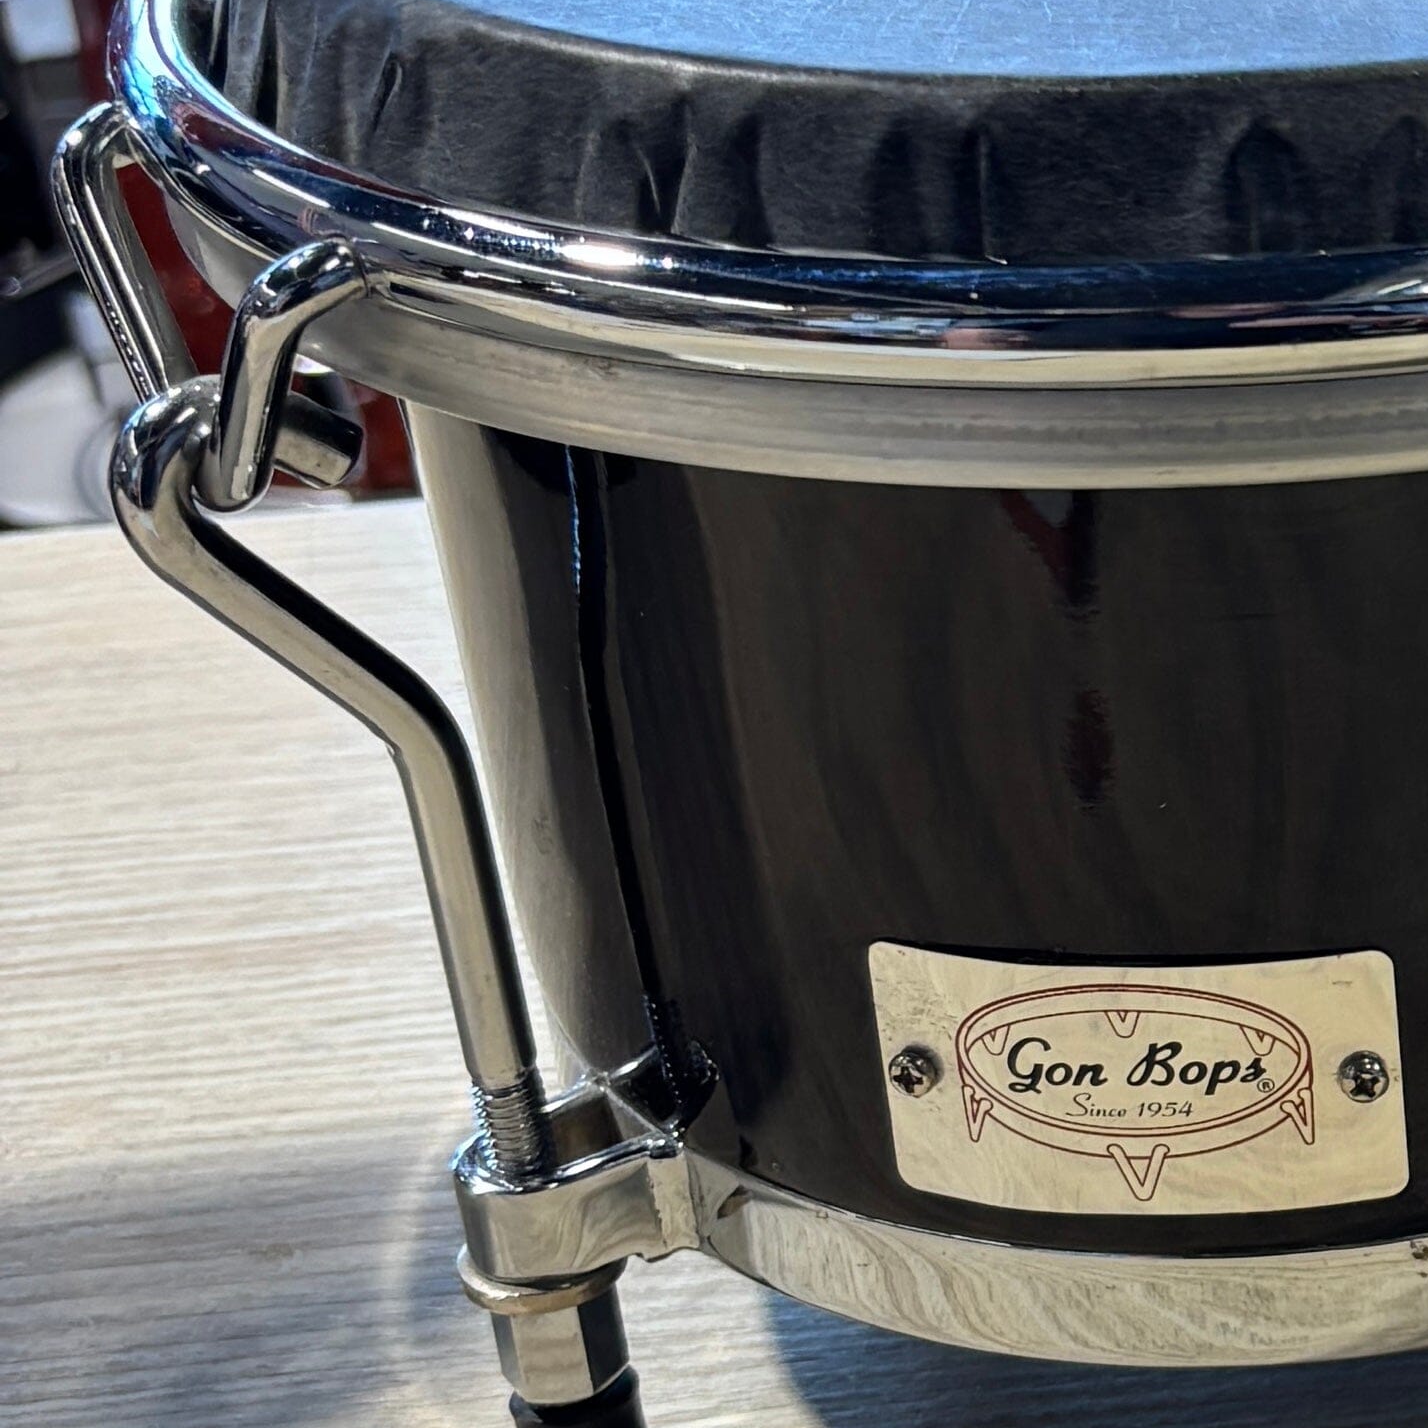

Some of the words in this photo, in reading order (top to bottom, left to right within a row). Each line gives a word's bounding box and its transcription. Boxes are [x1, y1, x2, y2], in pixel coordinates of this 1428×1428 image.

[1006, 1036, 1108, 1095] Gon
[1065, 1091, 1128, 1119] Since
[1136, 1099, 1194, 1119] 1954
